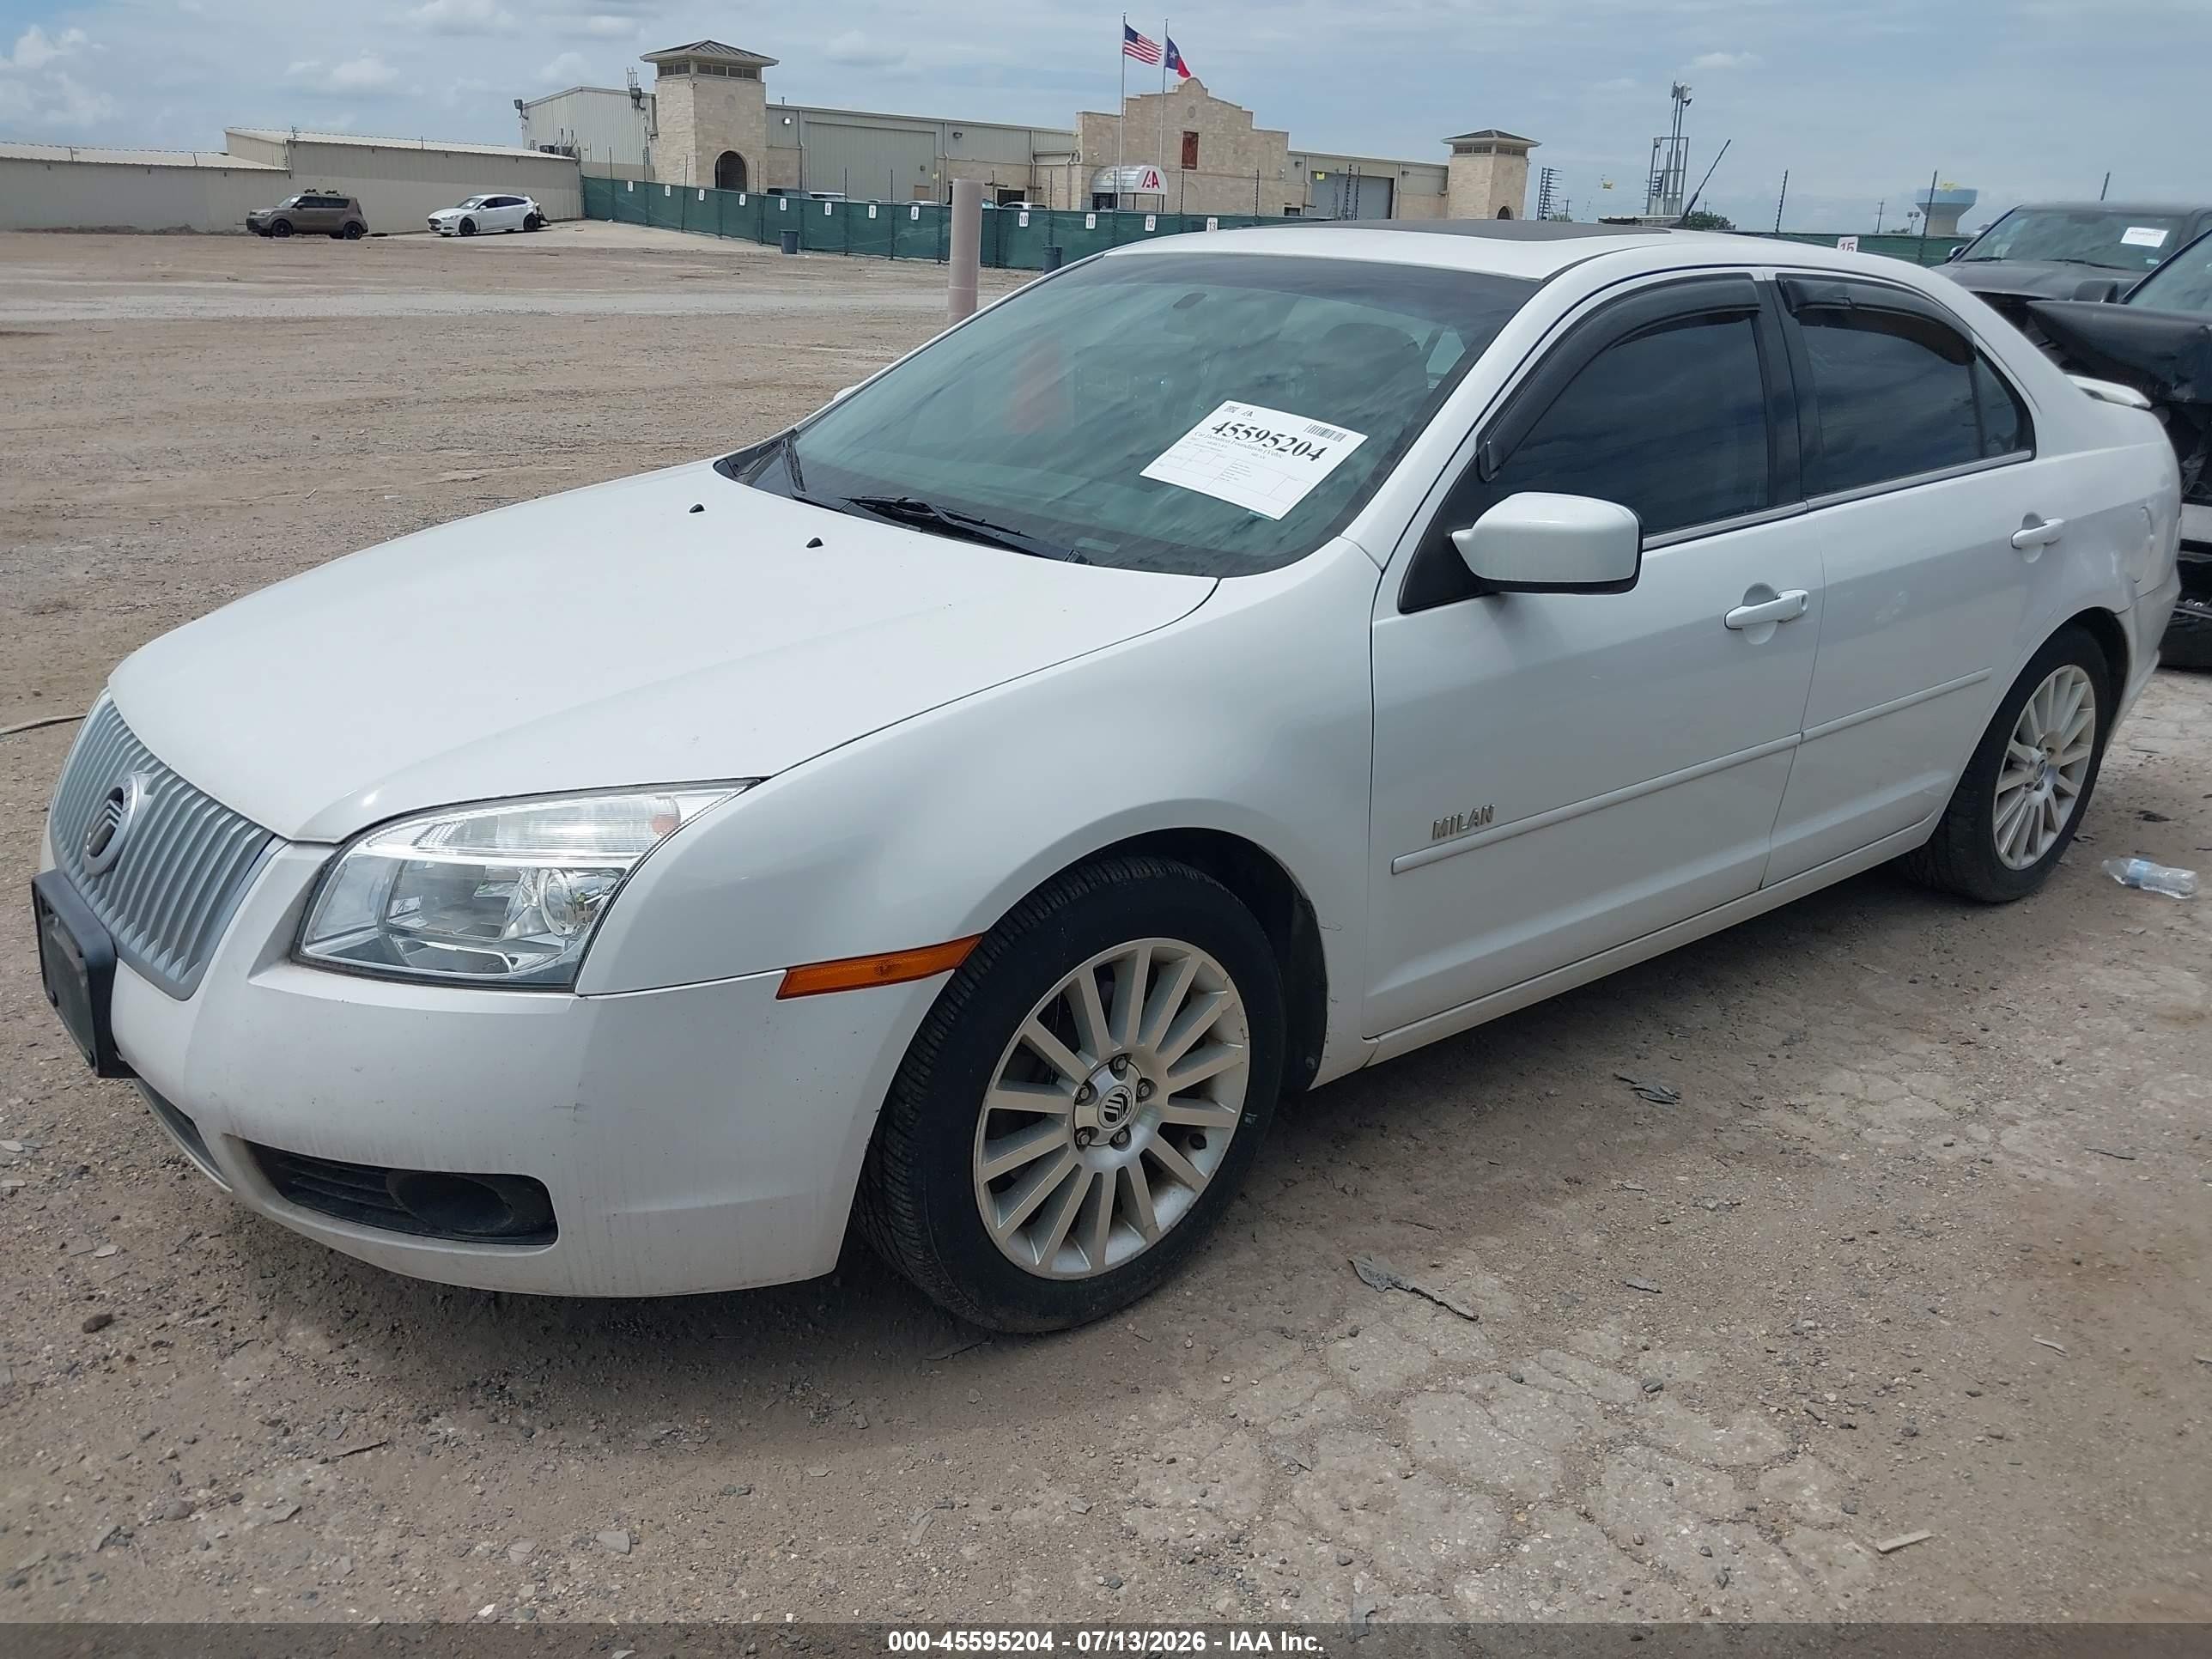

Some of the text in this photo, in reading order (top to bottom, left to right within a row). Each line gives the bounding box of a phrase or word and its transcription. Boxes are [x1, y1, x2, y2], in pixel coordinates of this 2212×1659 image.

[1020, 215, 1028, 225] 10
[1087, 216, 1095, 226] 11
[1147, 218, 1155, 228] 12
[1208, 221, 1217, 232] 13
[1840, 241, 1855, 252] 15
[1211, 420, 1328, 462] 45595204
[1432, 803, 1495, 841] MILAN
